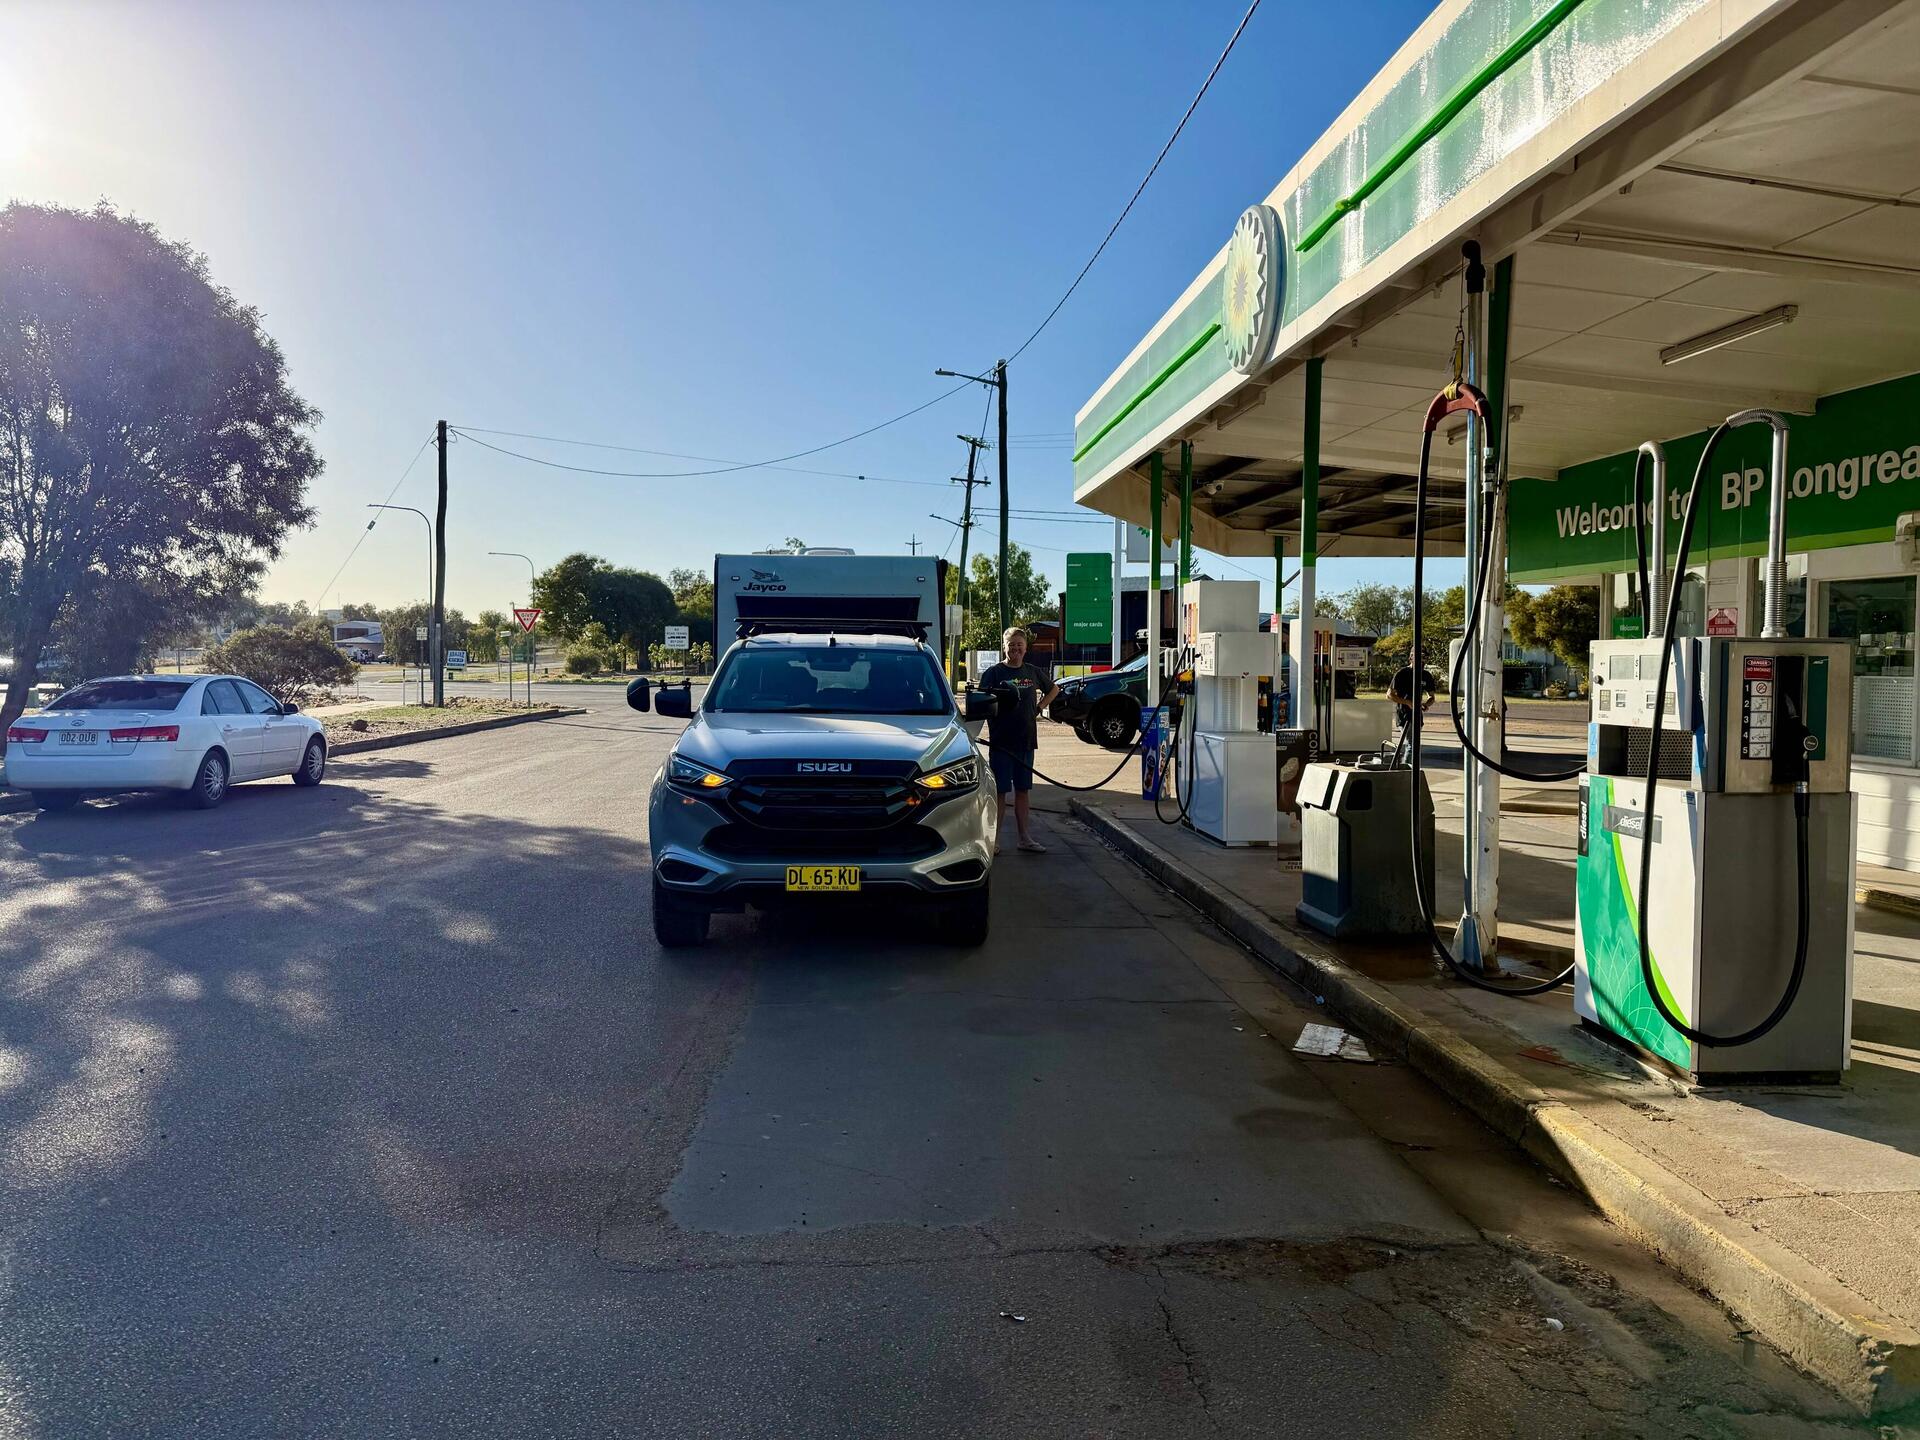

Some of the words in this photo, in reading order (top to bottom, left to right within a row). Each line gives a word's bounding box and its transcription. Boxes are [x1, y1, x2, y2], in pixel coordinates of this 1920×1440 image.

[1721, 467, 1765, 510] BP
[1787, 445, 1920, 500] ongrea
[743, 582, 787, 593] Jayco
[1744, 684, 1749, 692] 1
[1744, 700, 1750, 708] 2
[1743, 716, 1749, 724] 3
[1743, 731, 1749, 739] 4
[1742, 746, 1748, 754] 5
[797, 762, 852, 772] ISUZU
[1579, 801, 1588, 840] diesel
[1620, 815, 1643, 830] diesel
